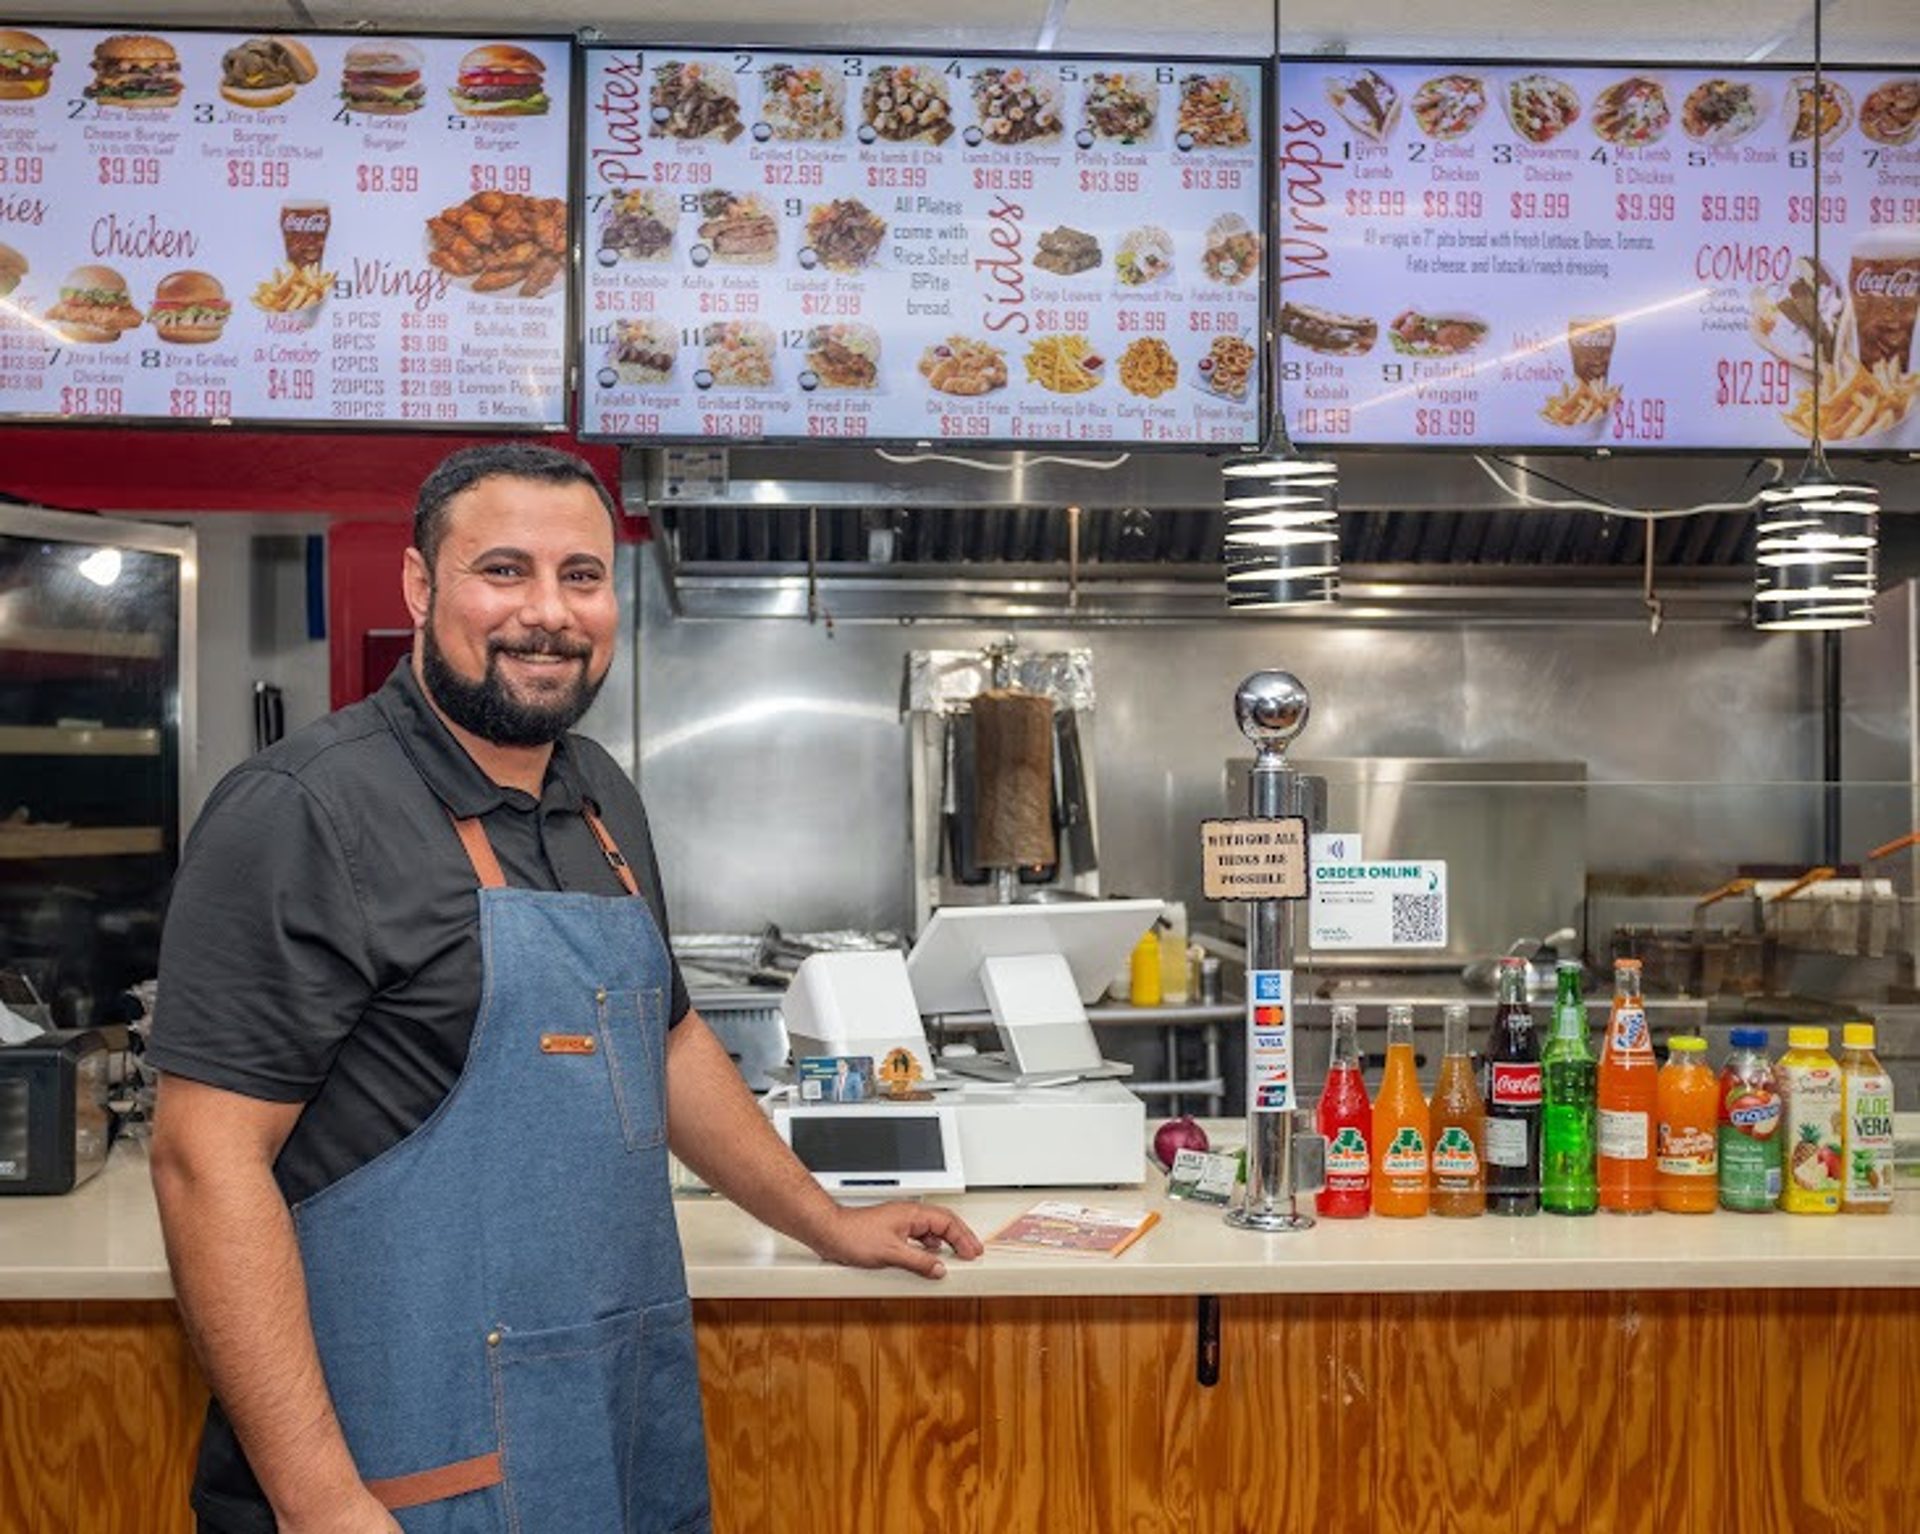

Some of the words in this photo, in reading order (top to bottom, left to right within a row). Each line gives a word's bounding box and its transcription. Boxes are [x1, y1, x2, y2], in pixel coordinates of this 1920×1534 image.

[843, 57, 863, 77] 3
[1156, 66, 1174, 84] 6
[592, 54, 648, 184] Plates
[99, 156, 160, 185] $9.99
[228, 160, 290, 188] $9.99
[357, 164, 418, 192] $8.99
[470, 165, 531, 193] $9.99
[652, 162, 713, 183] $12.99
[764, 164, 824, 185] $12.99
[868, 166, 927, 188] $13.99
[1079, 169, 1140, 192] $13.99
[1182, 167, 1242, 190] $13.99
[681, 194, 698, 213] 8
[894, 196, 914, 214] All
[917, 197, 963, 215] Plates
[1279, 106, 1345, 284] Wraps
[1344, 188, 1406, 217] $8.99
[1423, 189, 1483, 219] $8.99
[1510, 190, 1570, 219] $9.99
[1615, 192, 1675, 222] $9.99
[1701, 194, 1761, 222] $9.99
[1787, 196, 1847, 224] $999
[90, 213, 200, 259] Chicken
[894, 227, 934, 241] come
[938, 225, 969, 241] with
[975, 195, 1030, 334] Sides
[1695, 243, 1792, 282] COMBO
[354, 256, 452, 312] Wings
[348, 311, 381, 329] PCS
[401, 312, 448, 330] $6.99
[1035, 309, 1090, 331] $6.99
[781, 330, 803, 349] 12
[268, 368, 314, 400] $4.99
[1717, 360, 1790, 406] $12.99
[60, 386, 123, 416] $8.99
[170, 389, 232, 418] $8.99
[600, 413, 660, 434] $12.99
[703, 414, 764, 436] $13.99
[807, 416, 868, 437] $13.99
[940, 415, 989, 436] $9.99
[1415, 408, 1476, 437] $8.99
[1613, 397, 1666, 440] $4.99
[1208, 833, 1243, 847] WITH
[1246, 833, 1272, 846] GOD
[1275, 832, 1299, 845] ALL
[1263, 852, 1288, 865] ARE
[1221, 872, 1286, 885] POSSIBLE
[1315, 866, 1367, 881] ORDER
[1369, 866, 1423, 880] ONLINE
[1856, 1097, 1890, 1116] ALOE
[1855, 1118, 1892, 1137] VERA
